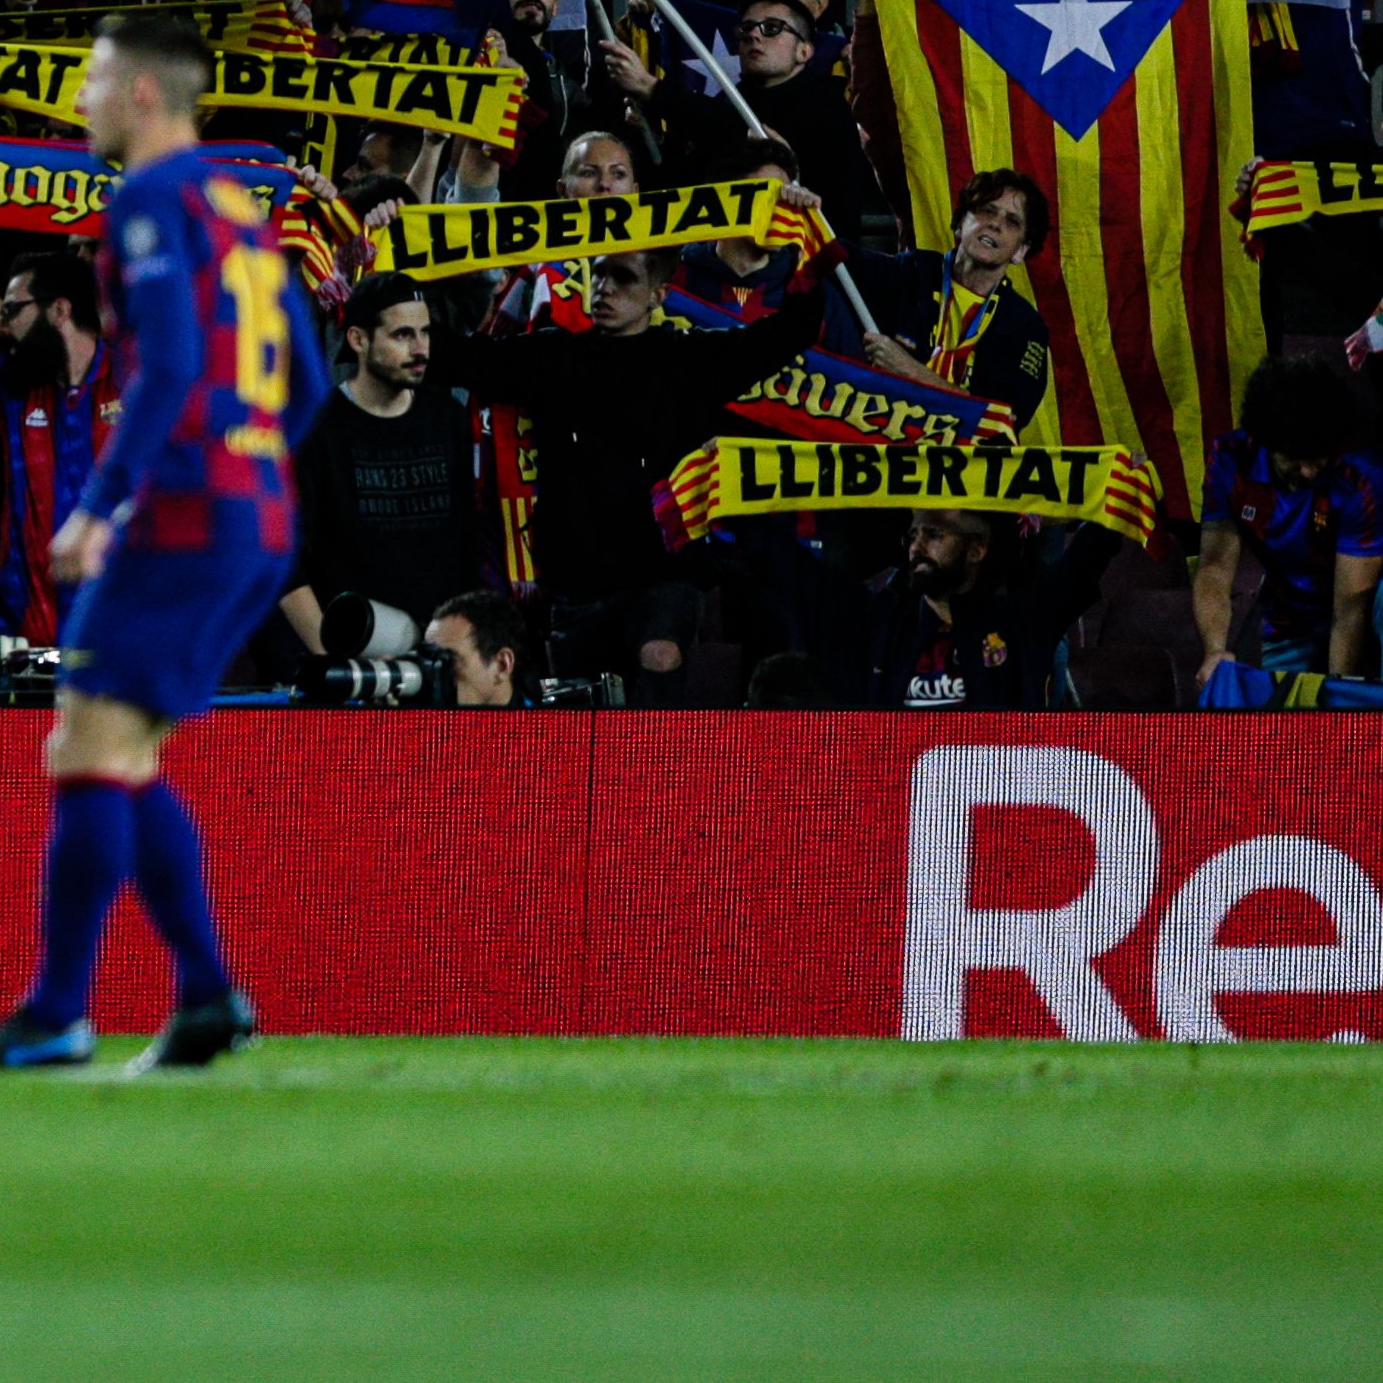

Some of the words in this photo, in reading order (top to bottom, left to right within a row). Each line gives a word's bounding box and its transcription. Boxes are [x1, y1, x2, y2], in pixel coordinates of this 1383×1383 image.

[388, 180, 770, 271] LLIBERTAT
[738, 445, 1100, 505] LLIBERTAT
[900, 744, 1383, 1043] Re
